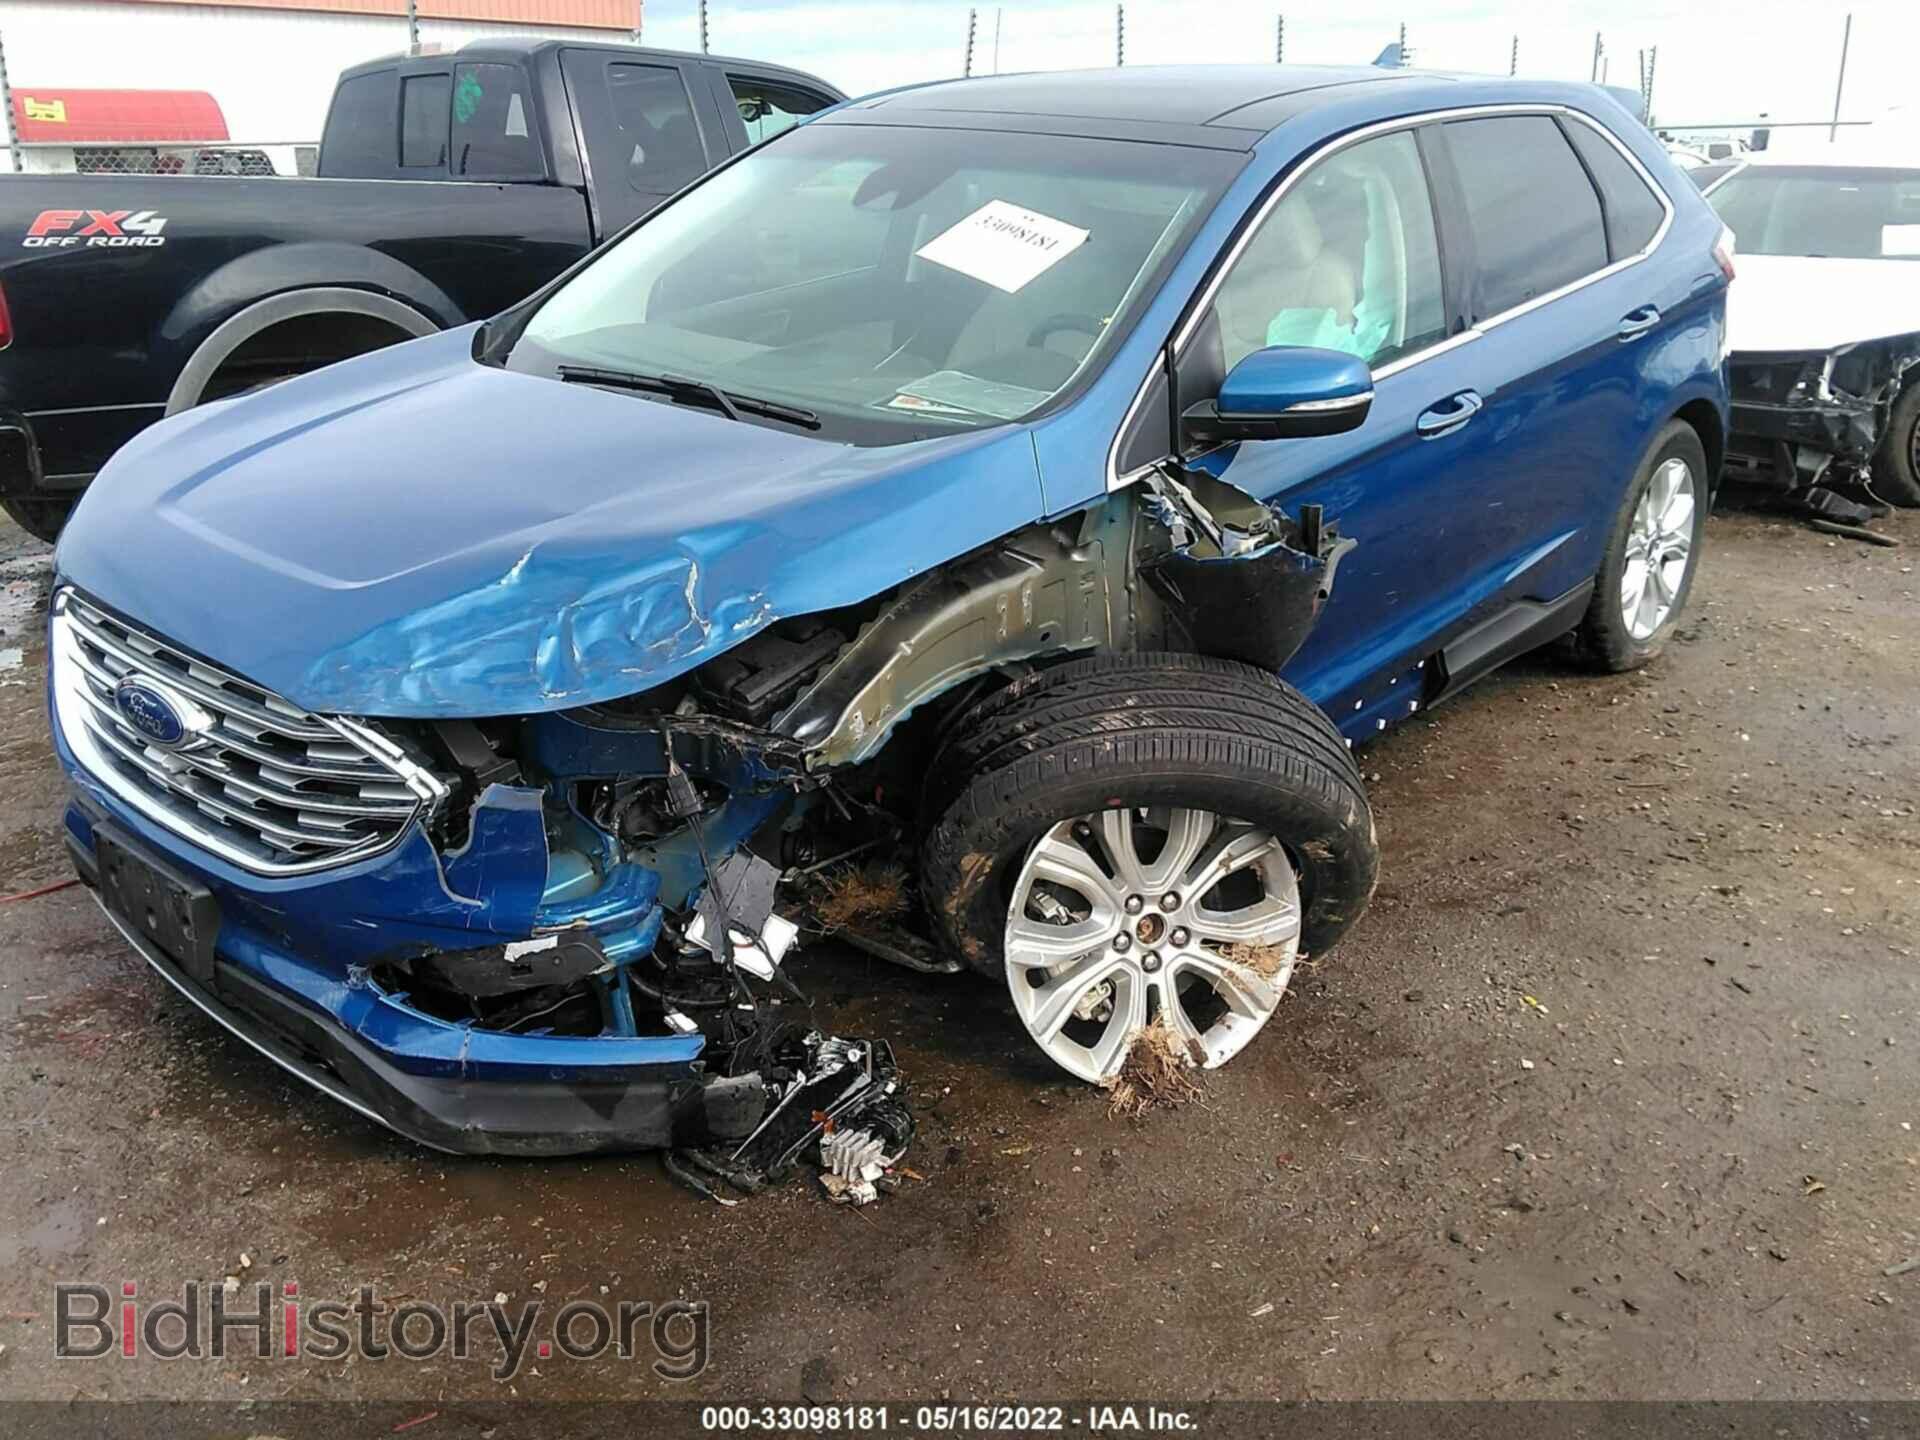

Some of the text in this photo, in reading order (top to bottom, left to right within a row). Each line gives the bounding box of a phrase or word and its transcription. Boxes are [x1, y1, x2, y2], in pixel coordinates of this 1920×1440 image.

[27, 209, 168, 236] FX4
[22, 236, 166, 247] OFF ROAD
[127, 692, 168, 736] Ford
